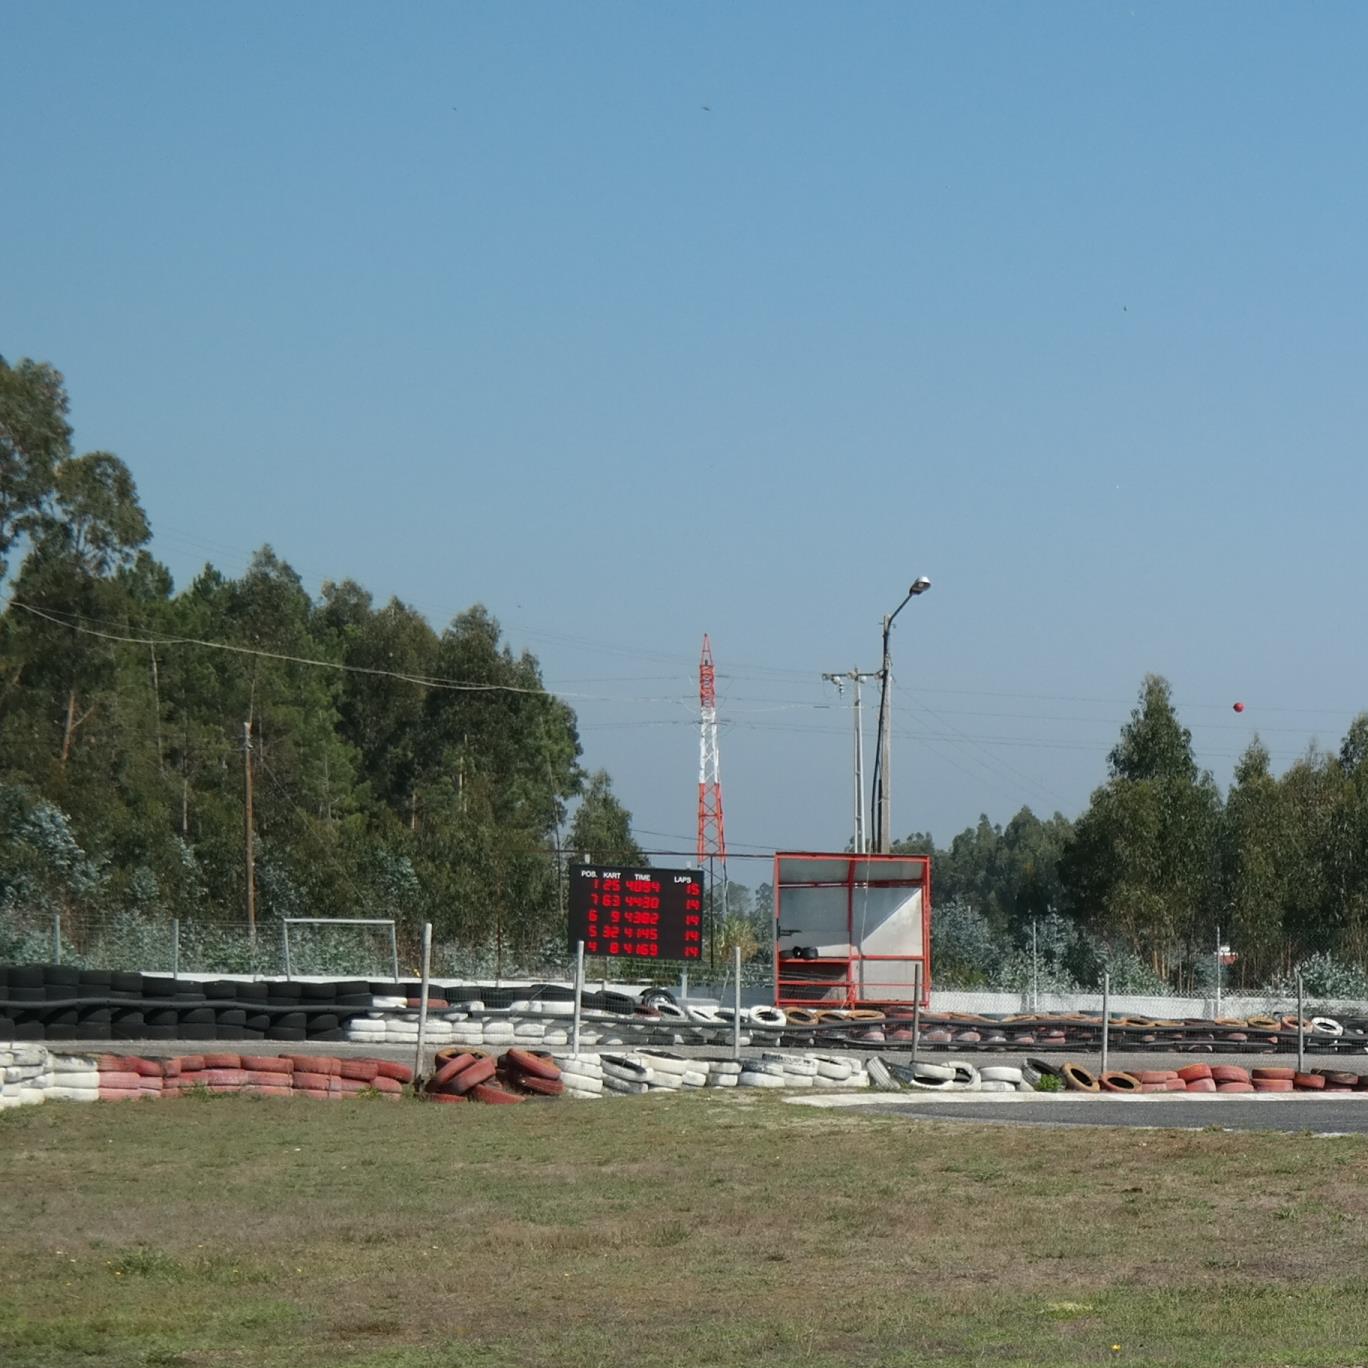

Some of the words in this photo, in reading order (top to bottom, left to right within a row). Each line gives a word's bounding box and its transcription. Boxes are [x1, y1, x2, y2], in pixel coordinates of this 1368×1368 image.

[581, 870, 598, 878] POS.
[674, 876, 692, 884] LAPS
[602, 880, 621, 892] 25
[686, 883, 700, 896] 15
[602, 894, 621, 907] 63
[588, 909, 598, 922] 6
[611, 910, 620, 923] 9
[588, 924, 598, 937] 5
[602, 925, 620, 938] 32
[587, 941, 598, 952] 4
